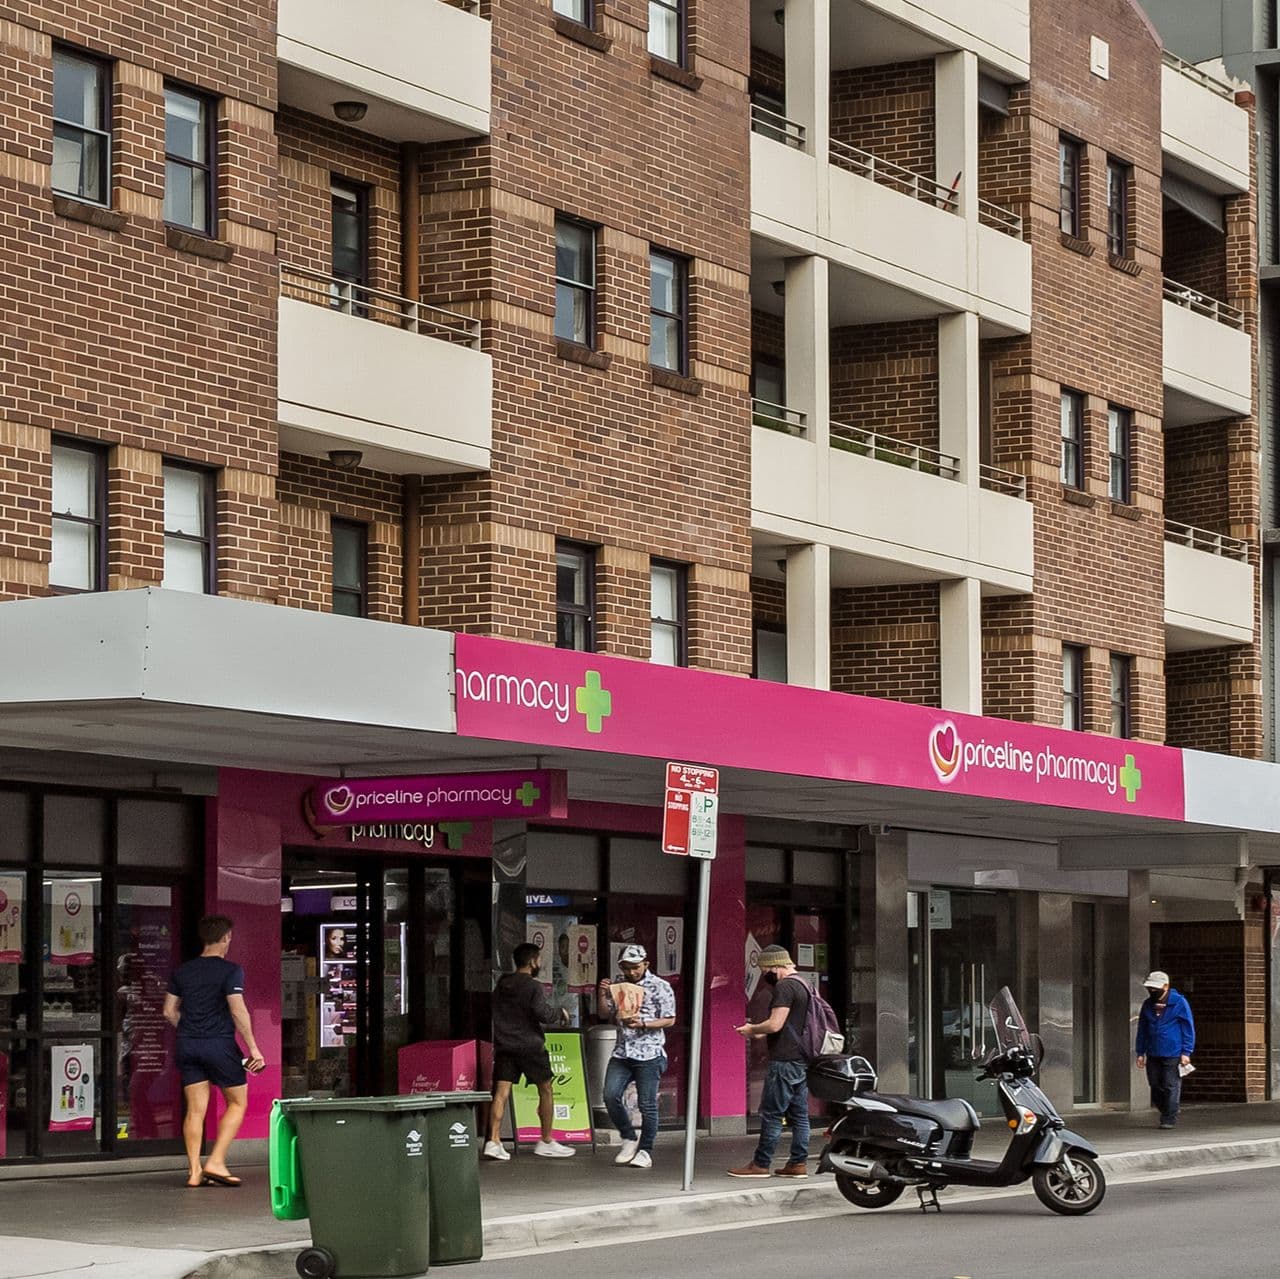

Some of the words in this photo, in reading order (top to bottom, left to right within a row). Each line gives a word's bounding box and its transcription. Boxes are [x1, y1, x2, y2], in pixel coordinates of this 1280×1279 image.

[682, 766, 715, 778] STOPPING
[964, 739, 1033, 773] priceline
[1036, 745, 1117, 795] pharmacy
[356, 790, 423, 808] priceline
[426, 786, 512, 807] pharmacy
